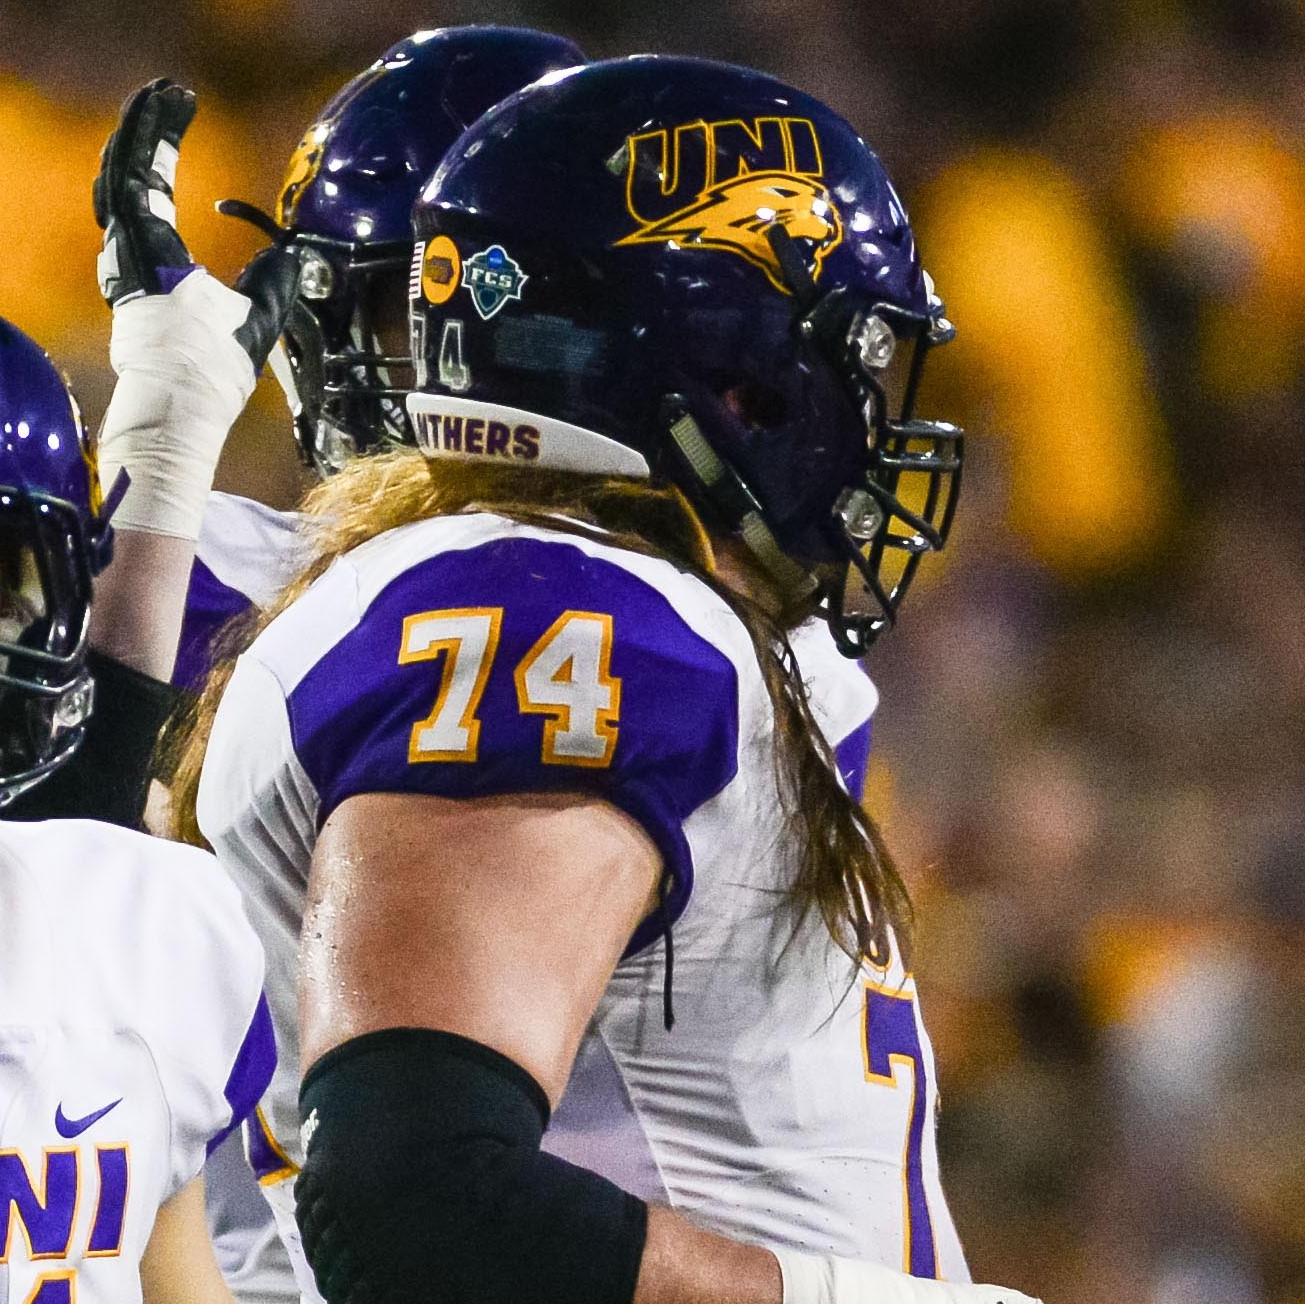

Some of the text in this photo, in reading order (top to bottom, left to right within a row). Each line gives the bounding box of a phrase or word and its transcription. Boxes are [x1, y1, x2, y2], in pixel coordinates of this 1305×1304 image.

[626, 116, 824, 224] UNI
[470, 266, 513, 290] FCS
[396, 606, 622, 769] 74
